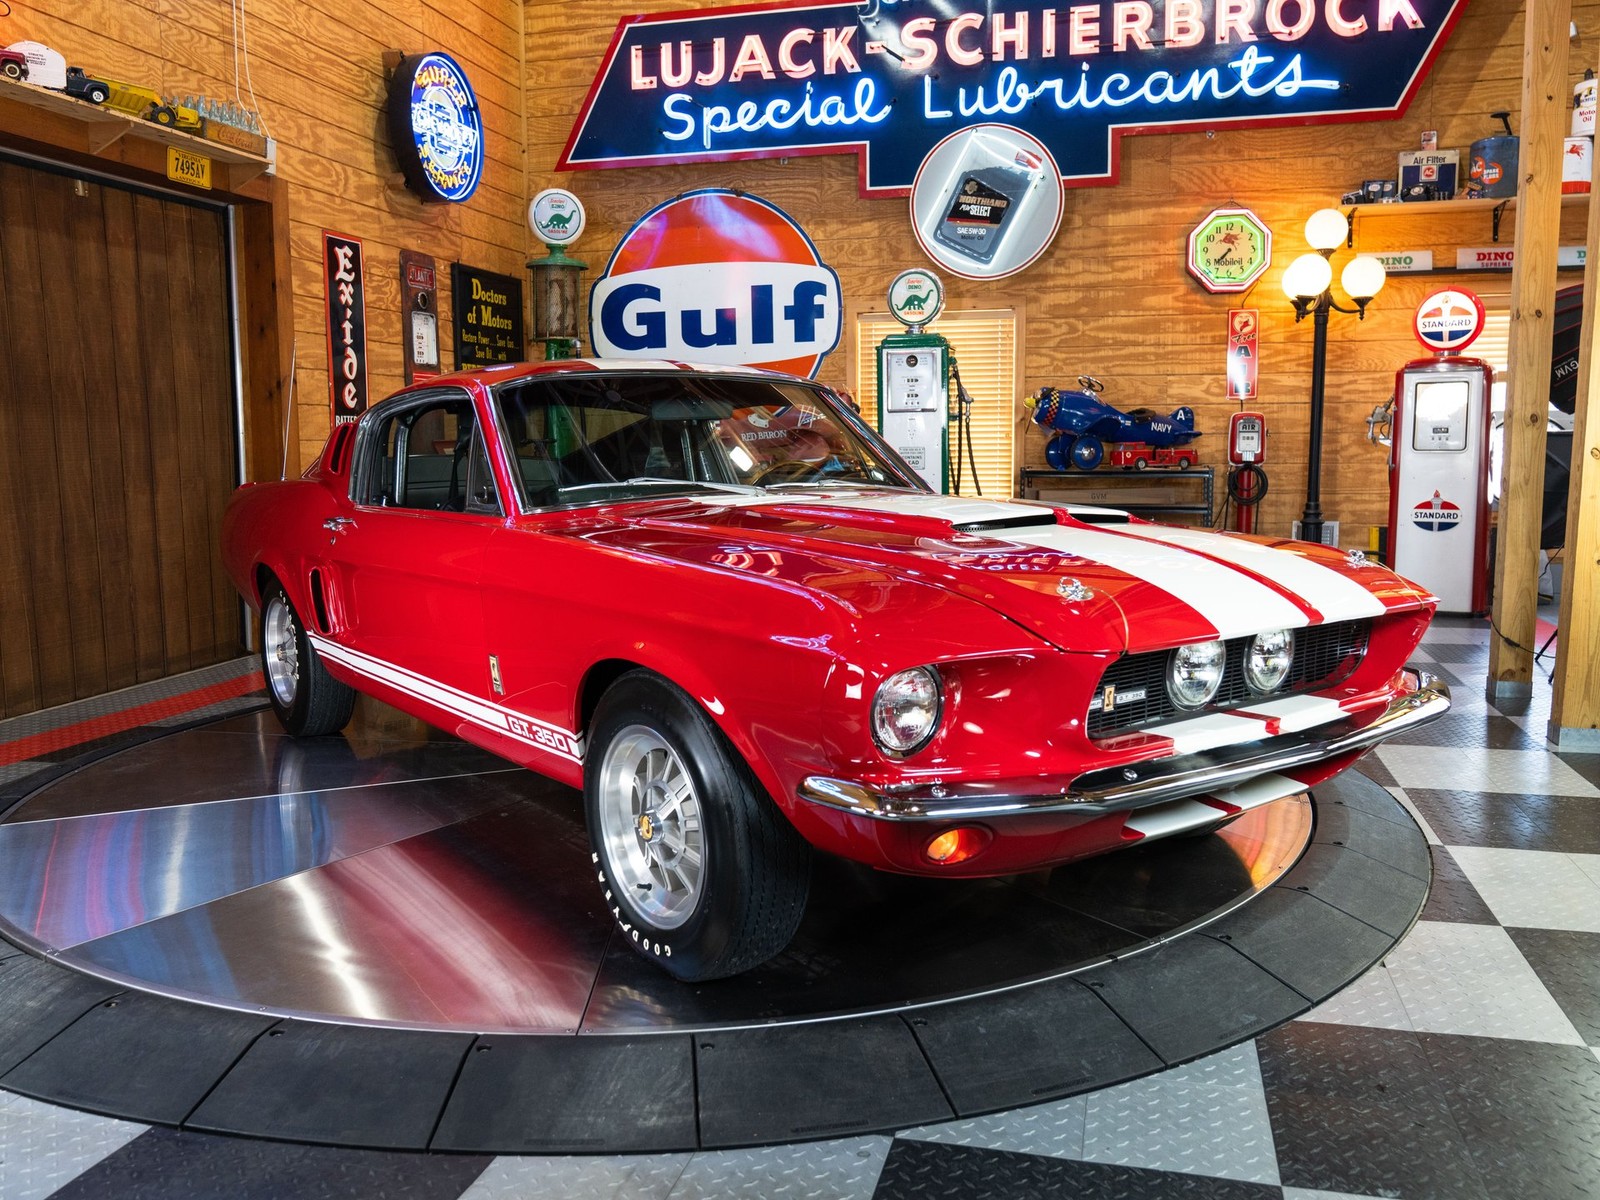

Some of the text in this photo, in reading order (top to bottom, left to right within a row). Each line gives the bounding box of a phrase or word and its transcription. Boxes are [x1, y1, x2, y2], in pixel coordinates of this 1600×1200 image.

[662, 45, 1340, 149] Special Lubricants
[1413, 155, 1447, 165] Air Filter
[175, 157, 206, 180] 7495AV
[1424, 168, 1434, 176] AC
[1471, 161, 1483, 173] AC
[959, 195, 1008, 208] NORTHLAND
[970, 205, 992, 217] SELECT
[1215, 226, 1222, 234] 11
[1226, 222, 1234, 231] 12
[1240, 225, 1244, 233] 1
[1206, 234, 1215, 243] 10
[1248, 232, 1253, 241] 2
[1203, 246, 1209, 255] 9
[1251, 245, 1256, 253] 3
[1247, 257, 1253, 265] 4
[1477, 251, 1514, 262] DINO
[1205, 258, 1211, 266] 8
[1213, 258, 1243, 266] Mobiloil
[1214, 267, 1219, 275] 7
[1226, 268, 1232, 277] 6
[1239, 265, 1245, 274] 5
[471, 278, 507, 305] Doctors
[466, 304, 513, 330] of Motors
[601, 280, 827, 352] Gulf
[333, 245, 358, 409] Exide
[1422, 319, 1471, 329] STANDARD
[1231, 333, 1257, 344] Free
[1554, 359, 1580, 380] GVM
[1176, 409, 1186, 421] A
[1150, 422, 1172, 433] NAVY
[741, 429, 787, 442] RED BARON
[1091, 492, 1108, 500] GVM
[1414, 511, 1459, 520] STANDARD
